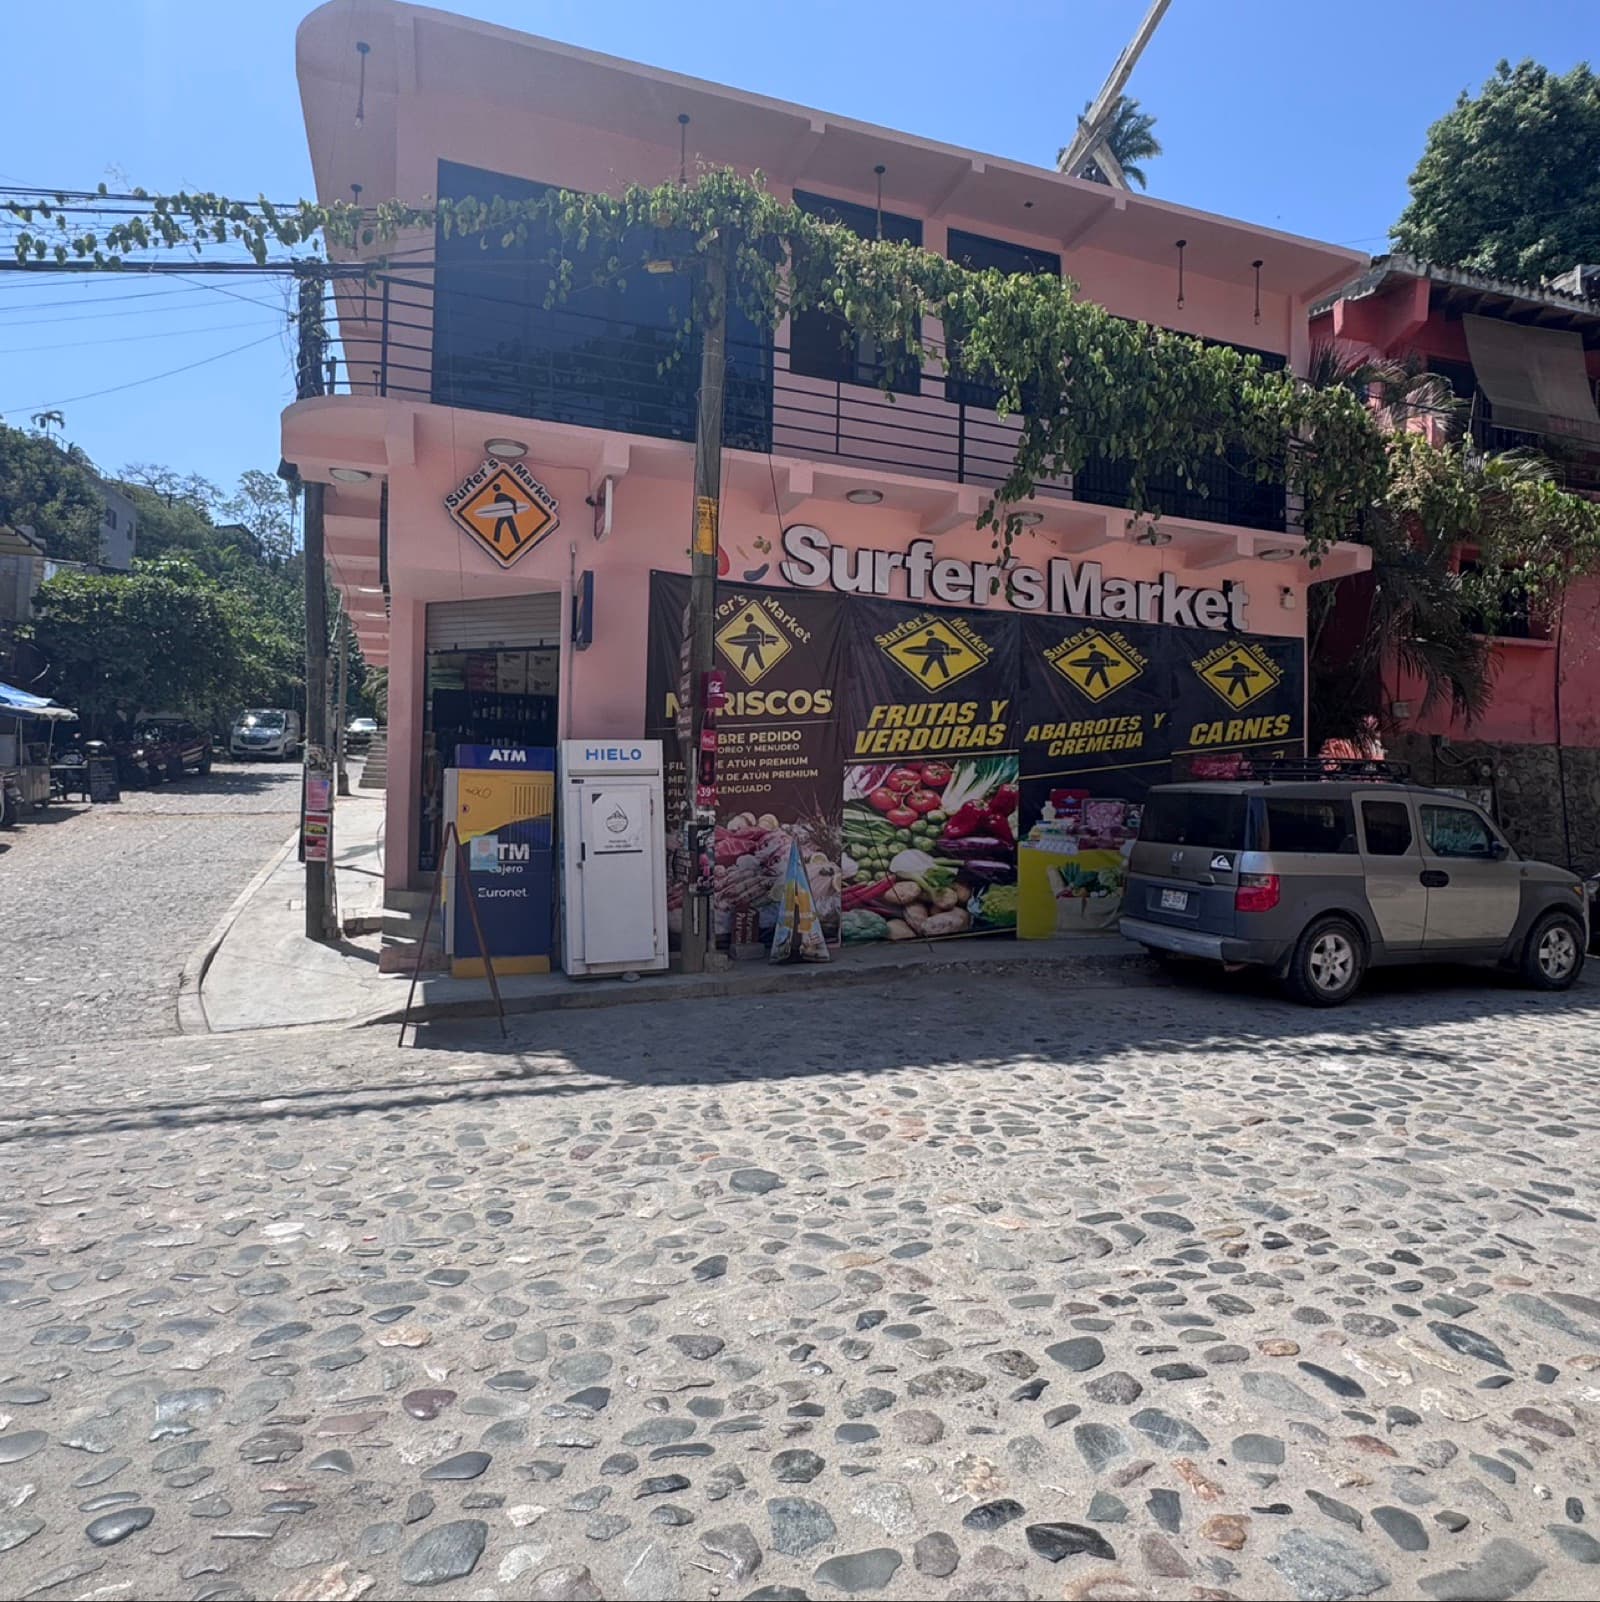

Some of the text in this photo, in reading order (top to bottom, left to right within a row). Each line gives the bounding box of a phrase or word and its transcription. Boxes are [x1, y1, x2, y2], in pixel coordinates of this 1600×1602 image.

[447, 458, 557, 510] Surfer's Market
[780, 524, 1250, 632] Surfer's Market
[715, 594, 812, 644] er's Market
[874, 613, 994, 655] Surfer's Market
[1043, 627, 1149, 666] Surfer's Market
[1250, 643, 1285, 676] Market
[665, 689, 832, 718] MRISCOS
[868, 700, 1009, 728] FRUTAS Y
[718, 733, 745, 745] BRE
[750, 731, 802, 743] PEDIDO
[854, 724, 1007, 754] VERDURAS
[1025, 712, 1166, 742] ABARROTES Y
[1189, 714, 1291, 745] CARNES
[489, 749, 527, 763] ATM
[586, 748, 642, 761] HIELO
[754, 743, 800, 752] MENUDEO
[1048, 732, 1143, 757] CREMERIA
[726, 773, 740, 781] DE
[742, 770, 769, 780] ATÚN
[772, 770, 818, 779] PREMIUM
[727, 758, 756, 768] ATÚN
[760, 757, 808, 767] PREMIUM
[717, 784, 772, 794] LENGUADO
[498, 843, 530, 860] TM
[478, 887, 529, 898] Euronet
